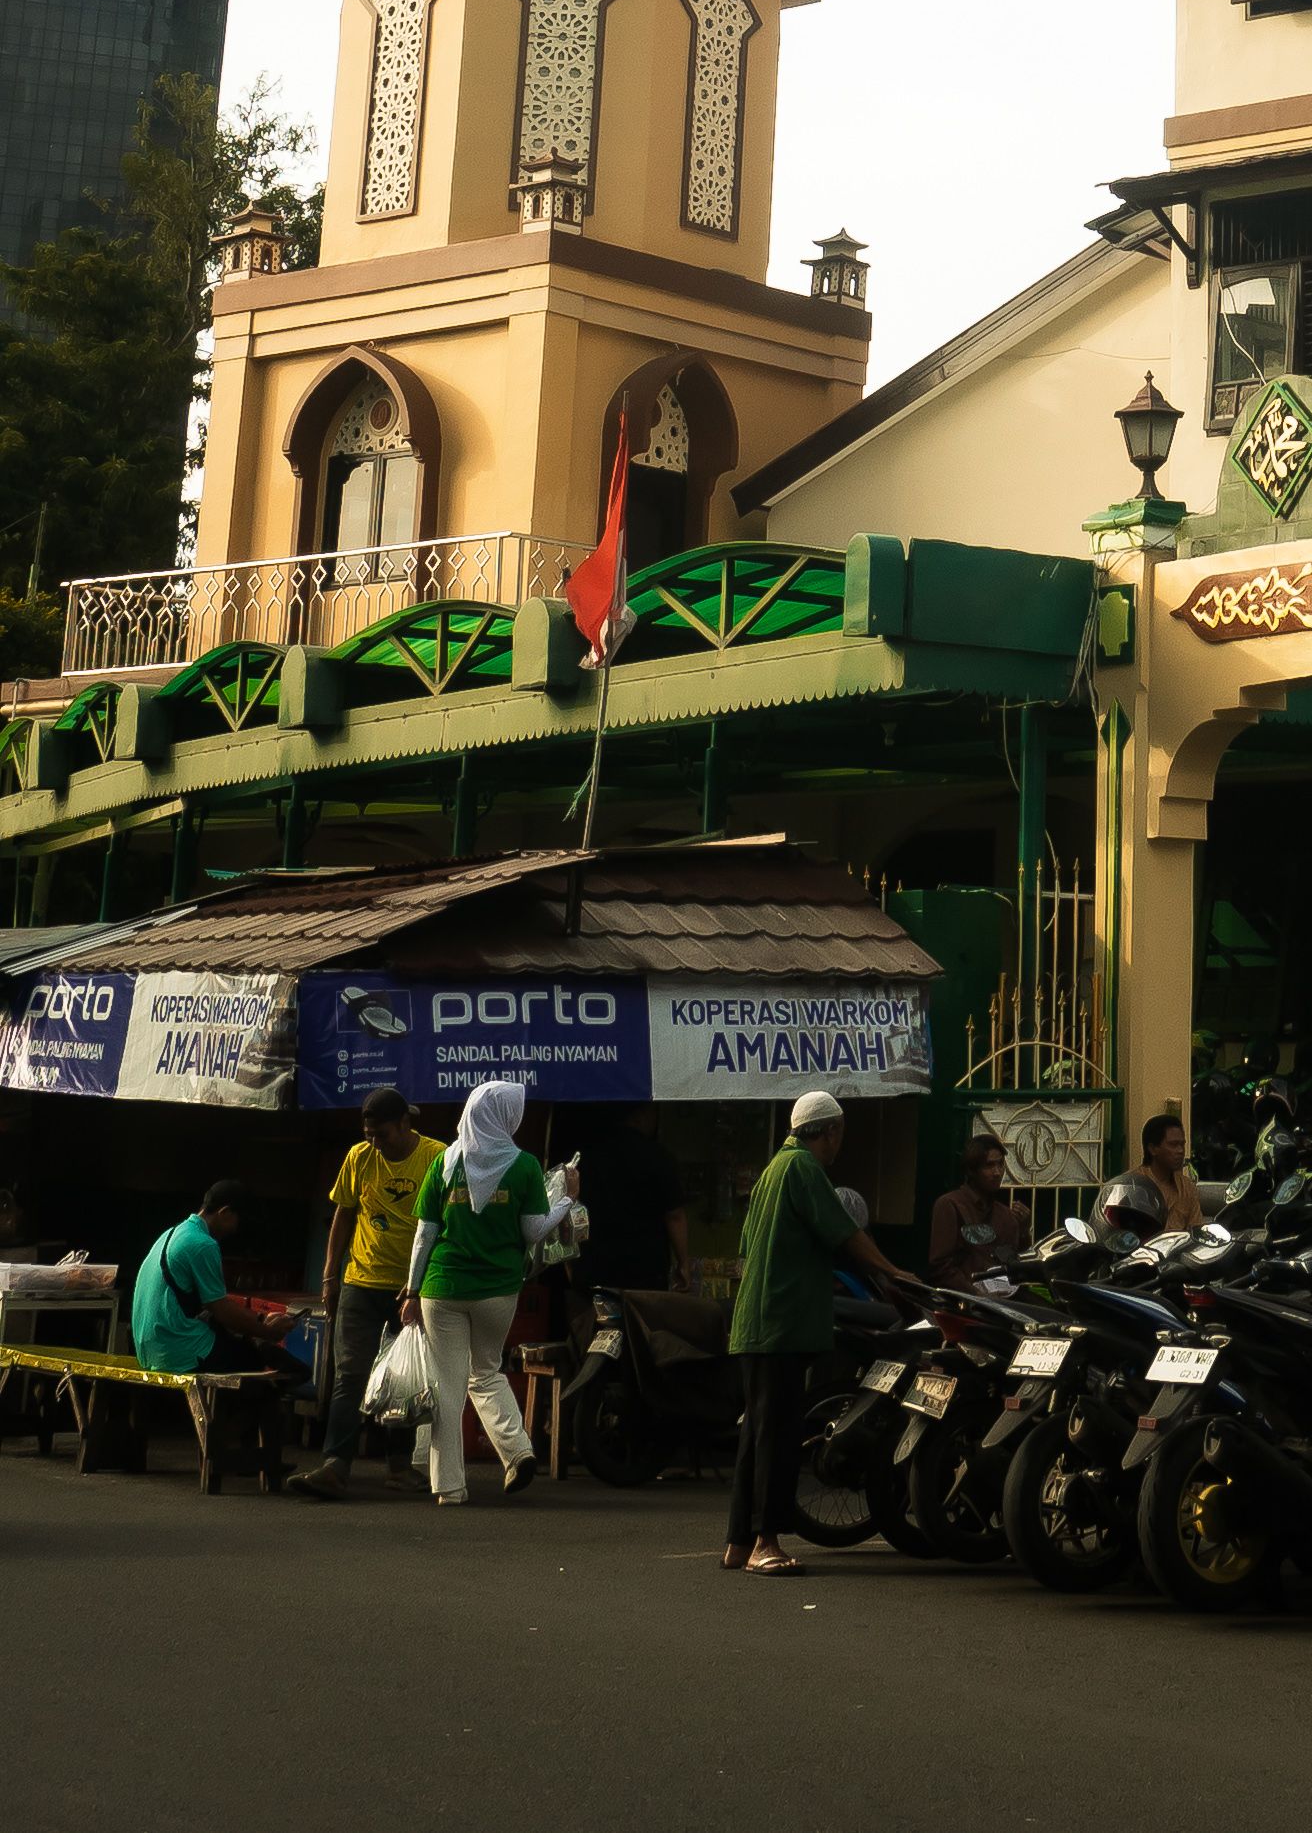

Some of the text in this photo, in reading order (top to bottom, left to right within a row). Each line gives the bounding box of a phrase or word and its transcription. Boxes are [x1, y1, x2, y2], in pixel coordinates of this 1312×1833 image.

[151, 994, 210, 1024] KOPERASI
[432, 985, 617, 1034] porto
[671, 999, 910, 1027] KOPERASI WARKOM
[155, 1030, 243, 1081] AMANAH
[436, 1045, 618, 1063] SANDAL PALING NYAMAN
[706, 1031, 888, 1074] AMANAH
[438, 1071, 451, 1088] DI
